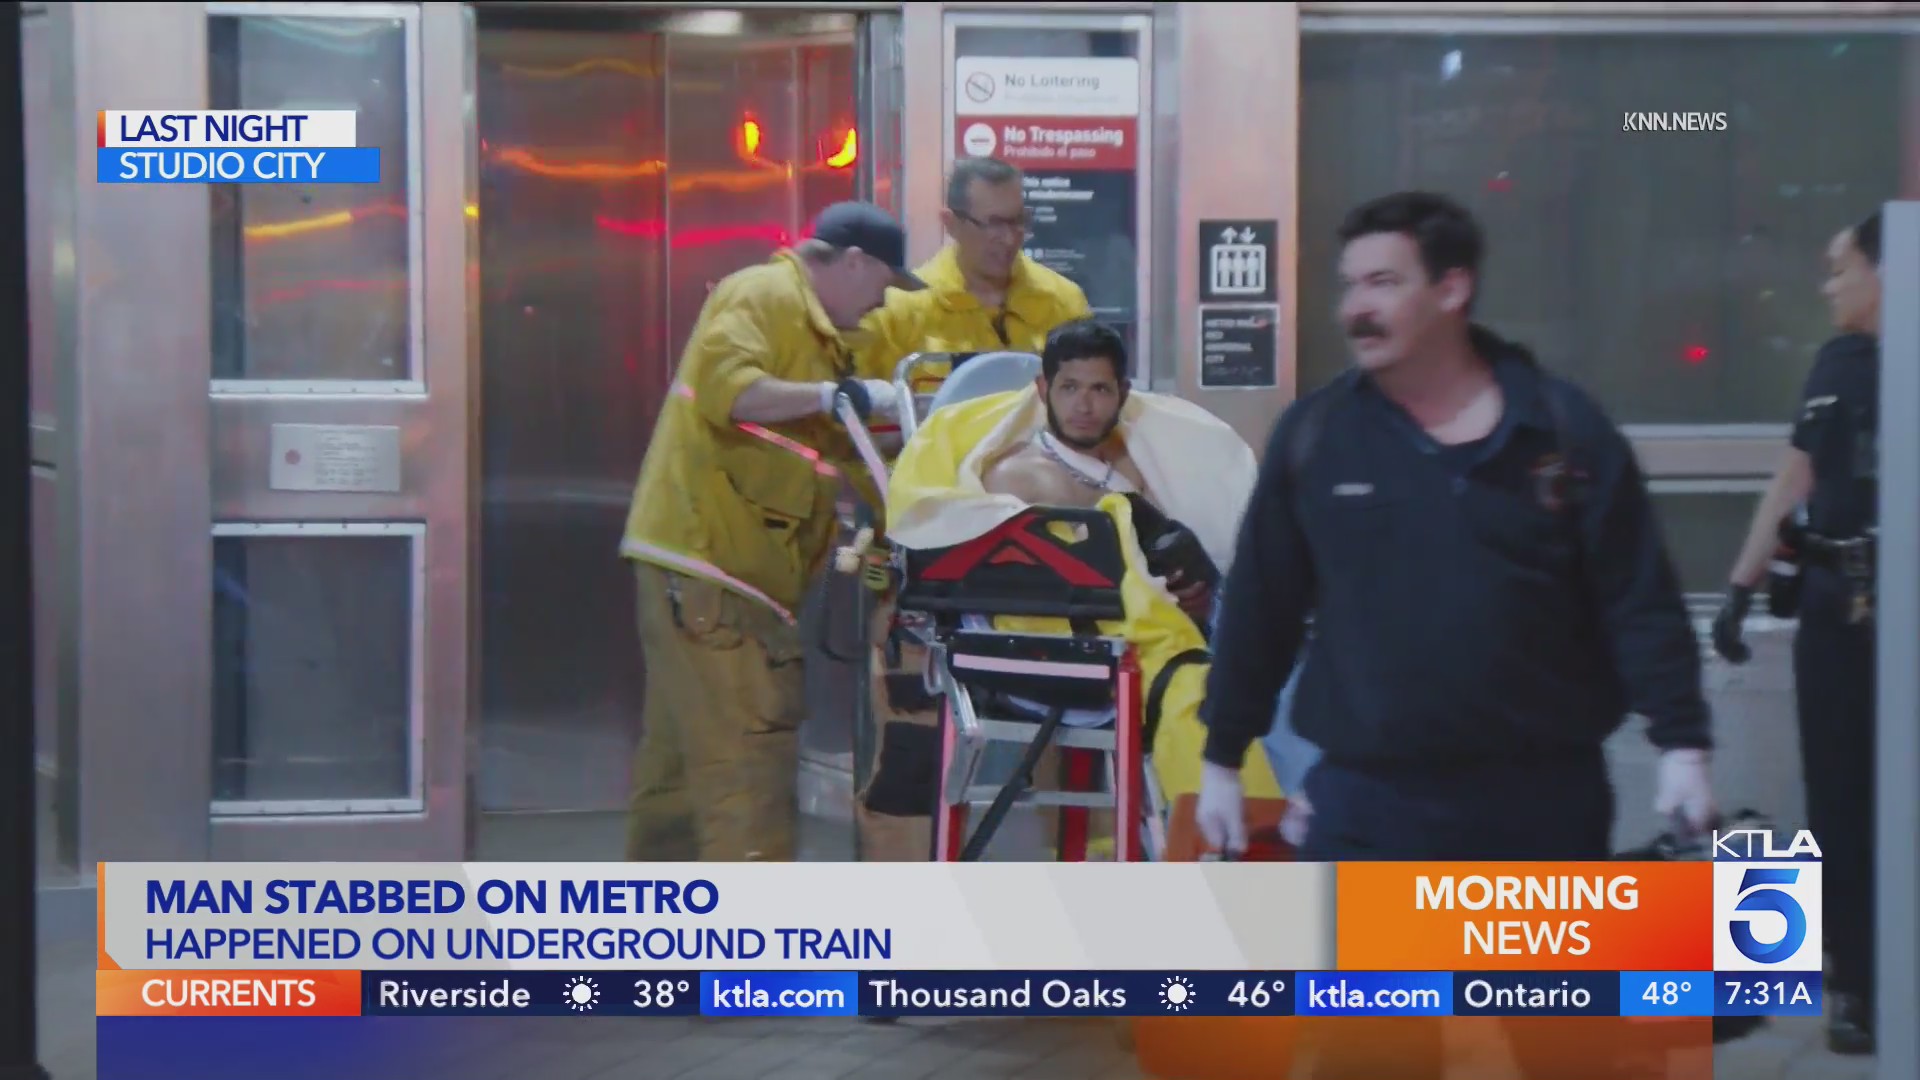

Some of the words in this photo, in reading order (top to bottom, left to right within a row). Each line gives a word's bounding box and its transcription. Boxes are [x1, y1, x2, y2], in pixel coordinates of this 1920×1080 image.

[1005, 74, 1025, 88] No
[1031, 73, 1100, 90] Loitering
[1004, 125, 1026, 143] No
[1030, 125, 1124, 147] Trespassing
